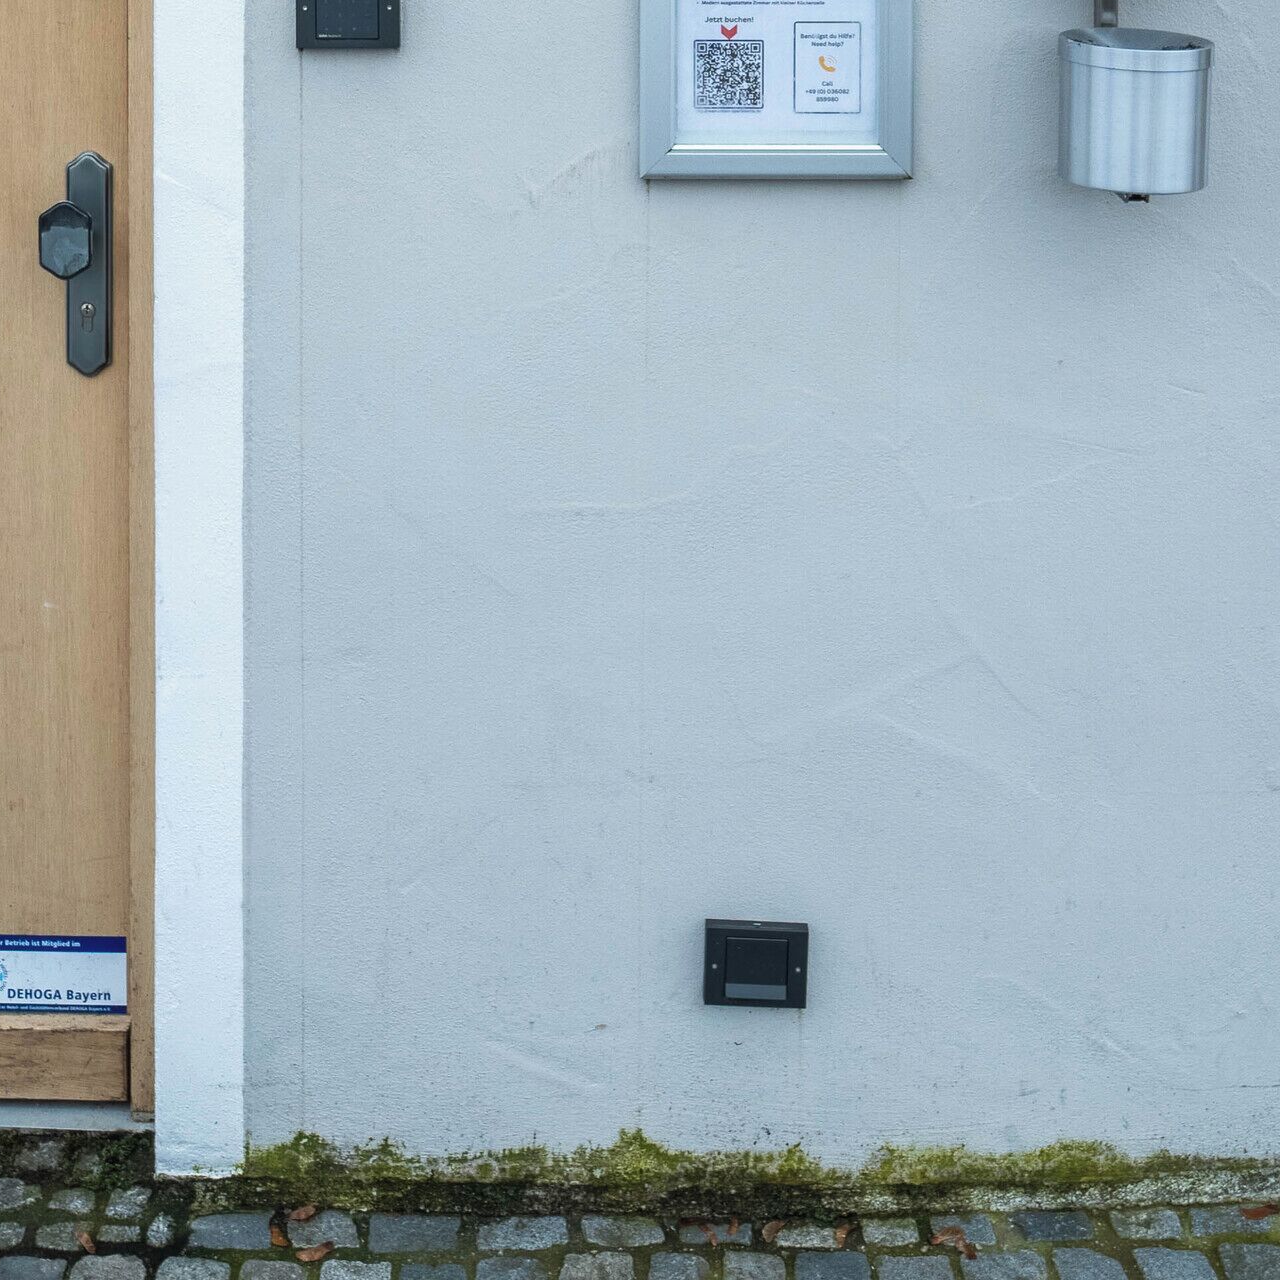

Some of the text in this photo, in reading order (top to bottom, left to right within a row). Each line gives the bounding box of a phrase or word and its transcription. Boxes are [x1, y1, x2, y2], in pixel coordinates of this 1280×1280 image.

[42, 940, 70, 948] Mitglied
[7, 988, 111, 1003] DEHOGA Bayern
